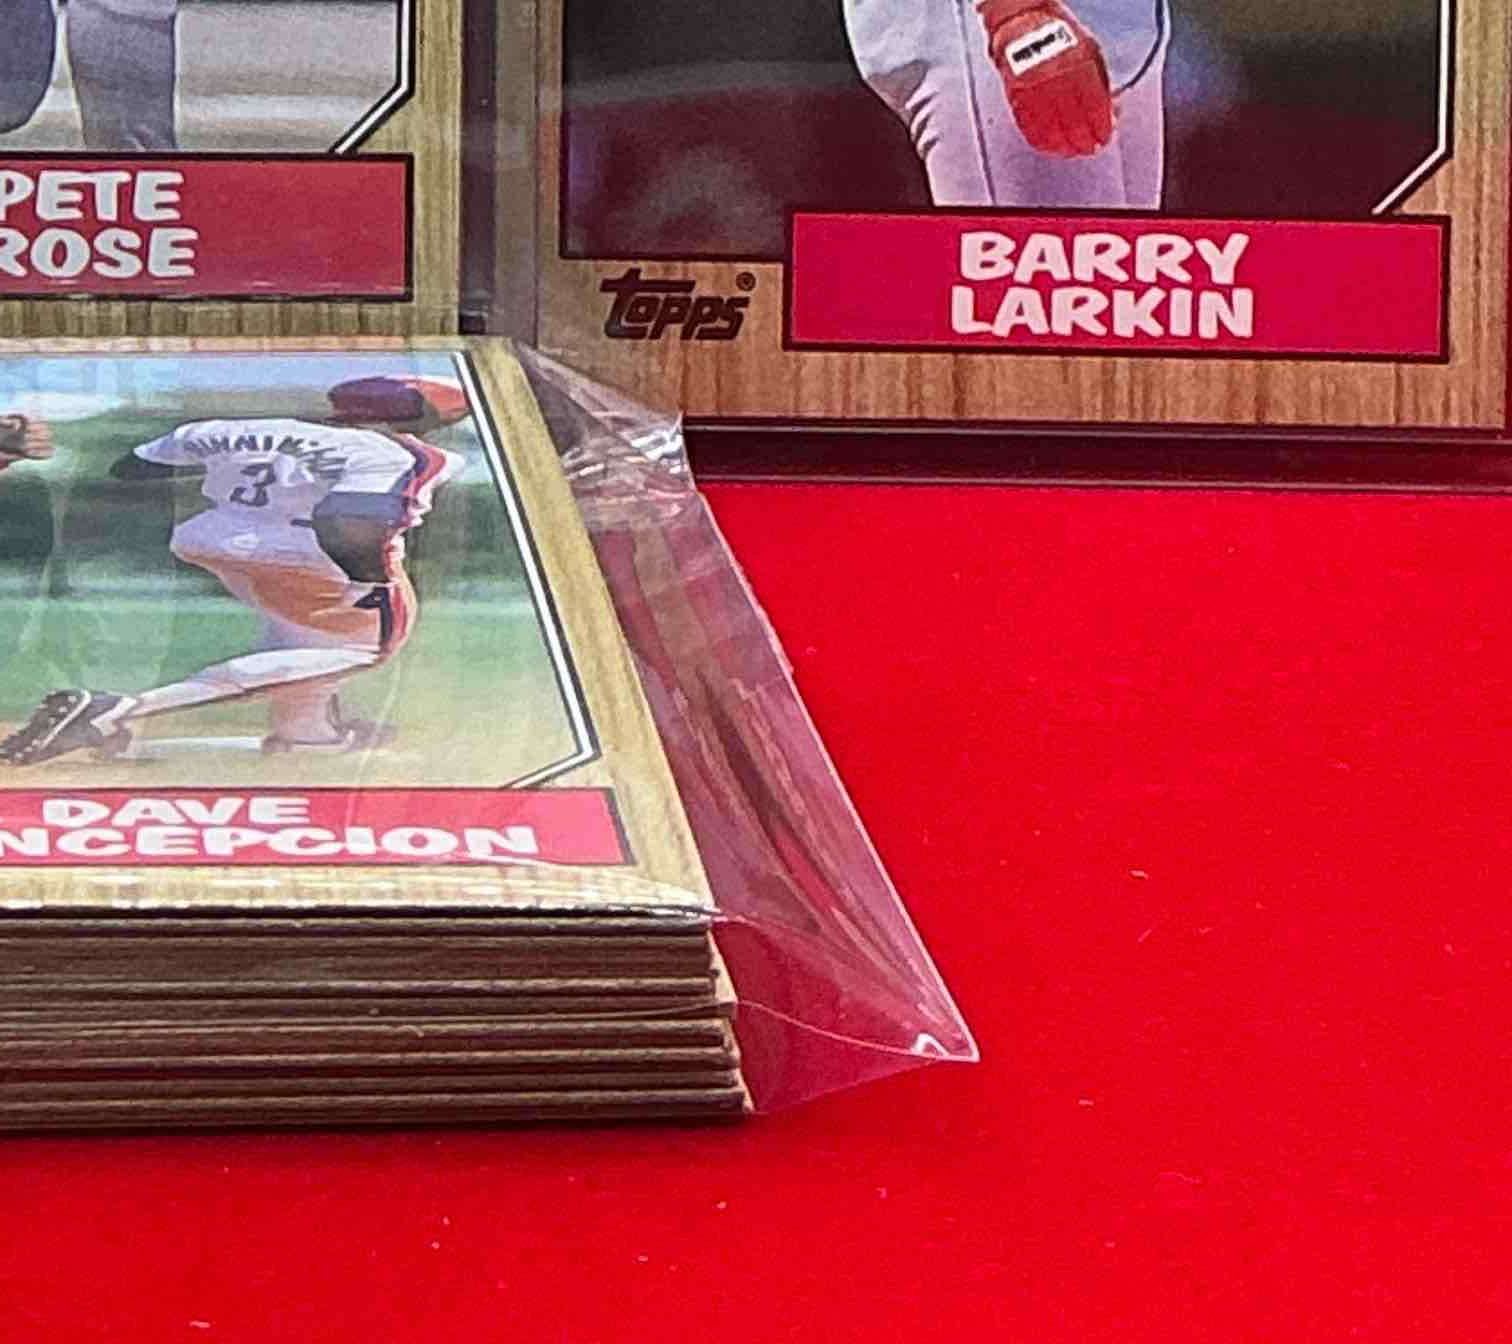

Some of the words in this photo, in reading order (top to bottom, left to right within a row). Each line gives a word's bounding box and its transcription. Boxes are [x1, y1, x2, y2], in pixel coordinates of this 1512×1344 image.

[960, 231, 1250, 285] BARRY
[951, 285, 1254, 339] LARKIN
[229, 463, 277, 507] 3
[41, 797, 311, 828] DAVE
